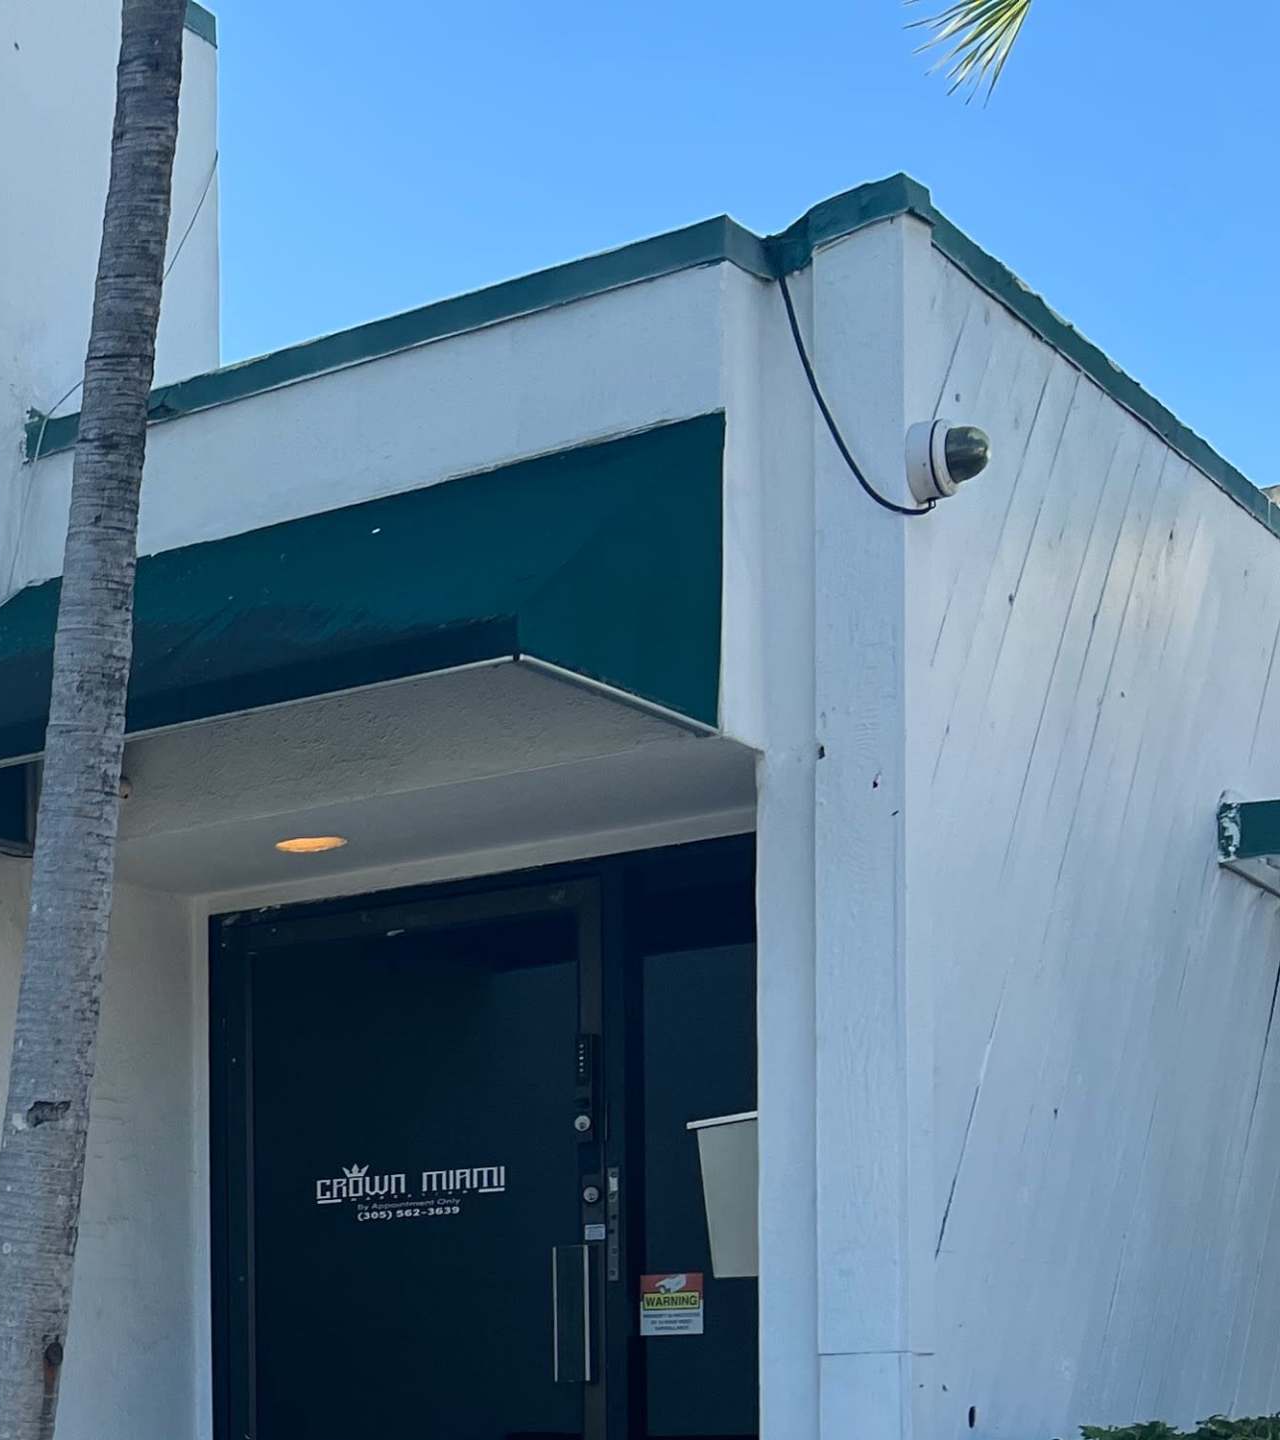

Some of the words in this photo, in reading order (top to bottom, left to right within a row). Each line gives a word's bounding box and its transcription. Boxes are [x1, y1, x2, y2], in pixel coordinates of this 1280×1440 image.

[316, 1173, 406, 1200] CROWN
[422, 1166, 506, 1192] MIAMI
[371, 1199, 434, 1210] Appointment
[436, 1198, 461, 1206] Only
[357, 1210, 393, 1222] (305)
[396, 1206, 460, 1218] 562-3639
[645, 1295, 698, 1307] WARNING
